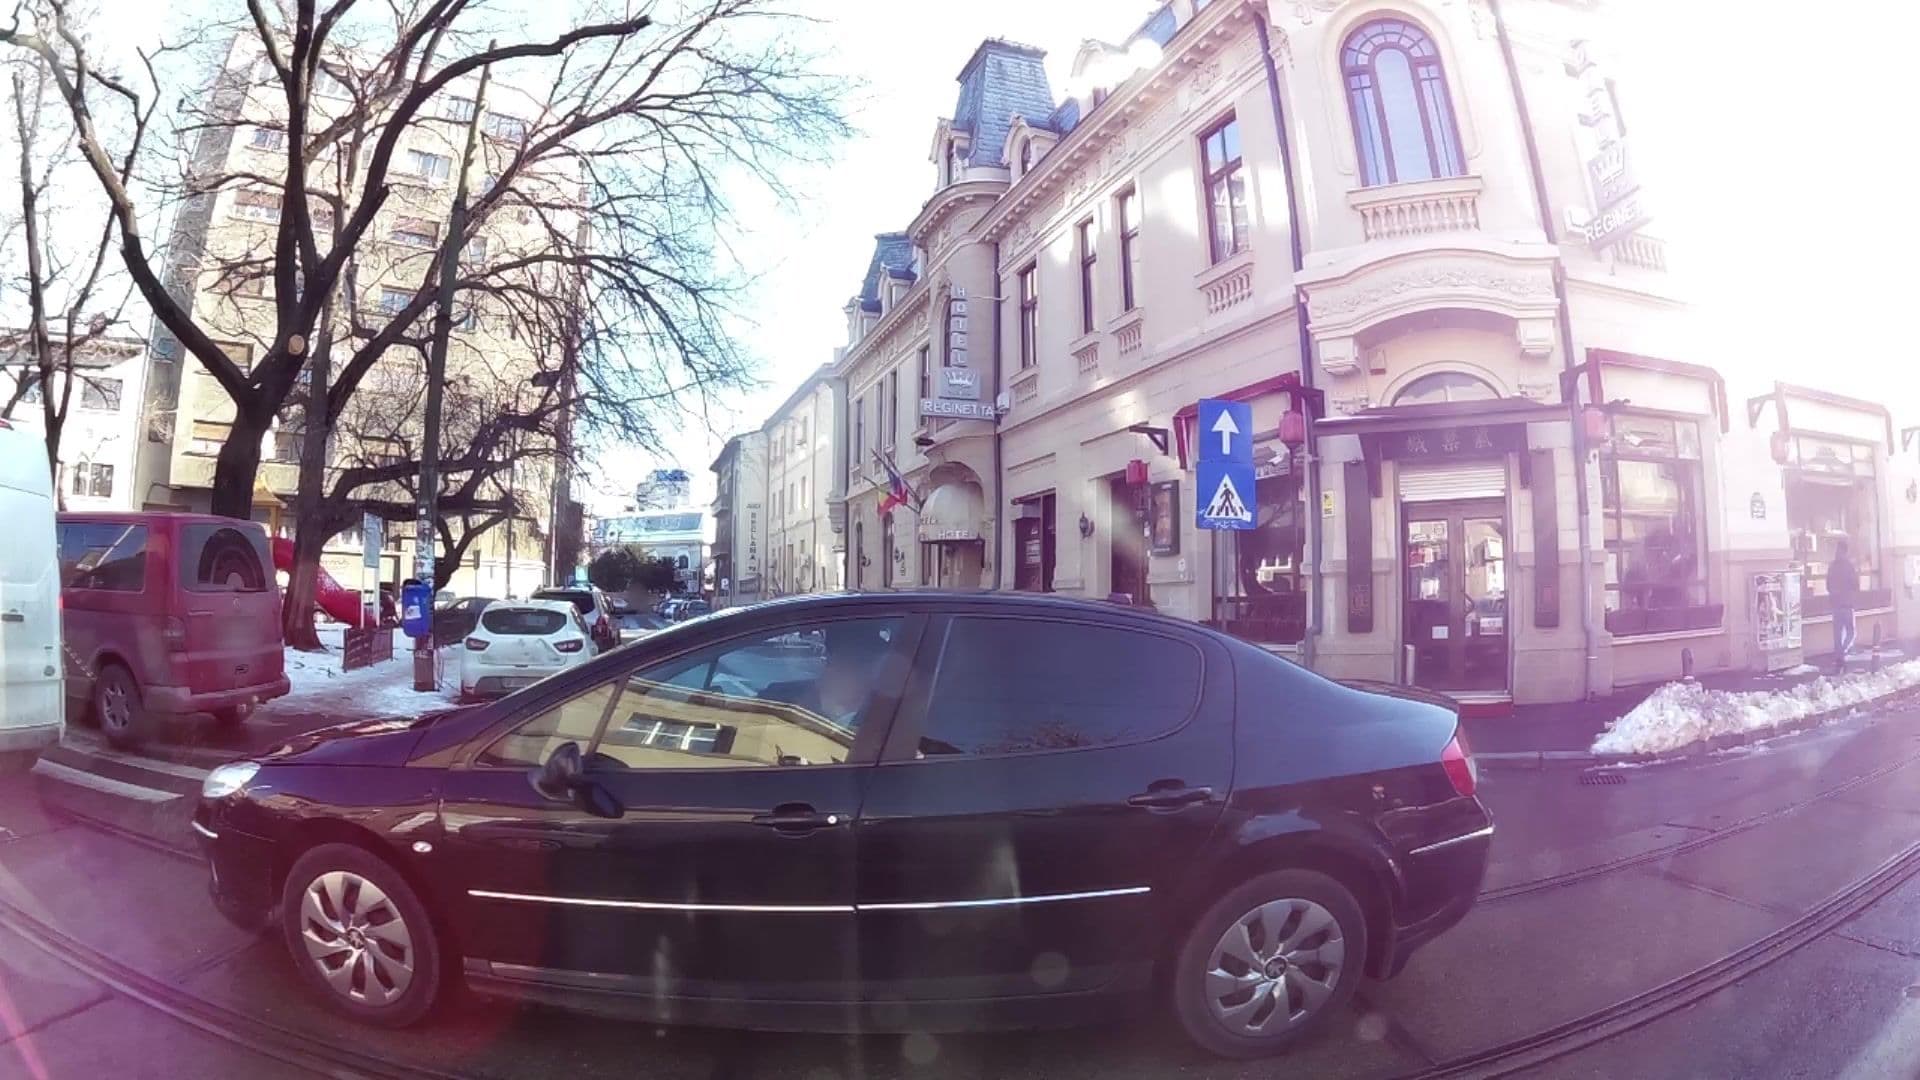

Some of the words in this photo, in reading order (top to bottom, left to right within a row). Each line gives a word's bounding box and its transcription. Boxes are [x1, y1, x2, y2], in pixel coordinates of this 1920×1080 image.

[956, 287, 967, 364] HOTEL
[923, 401, 994, 417] REGINETTA
[938, 529, 974, 541] HOTE
